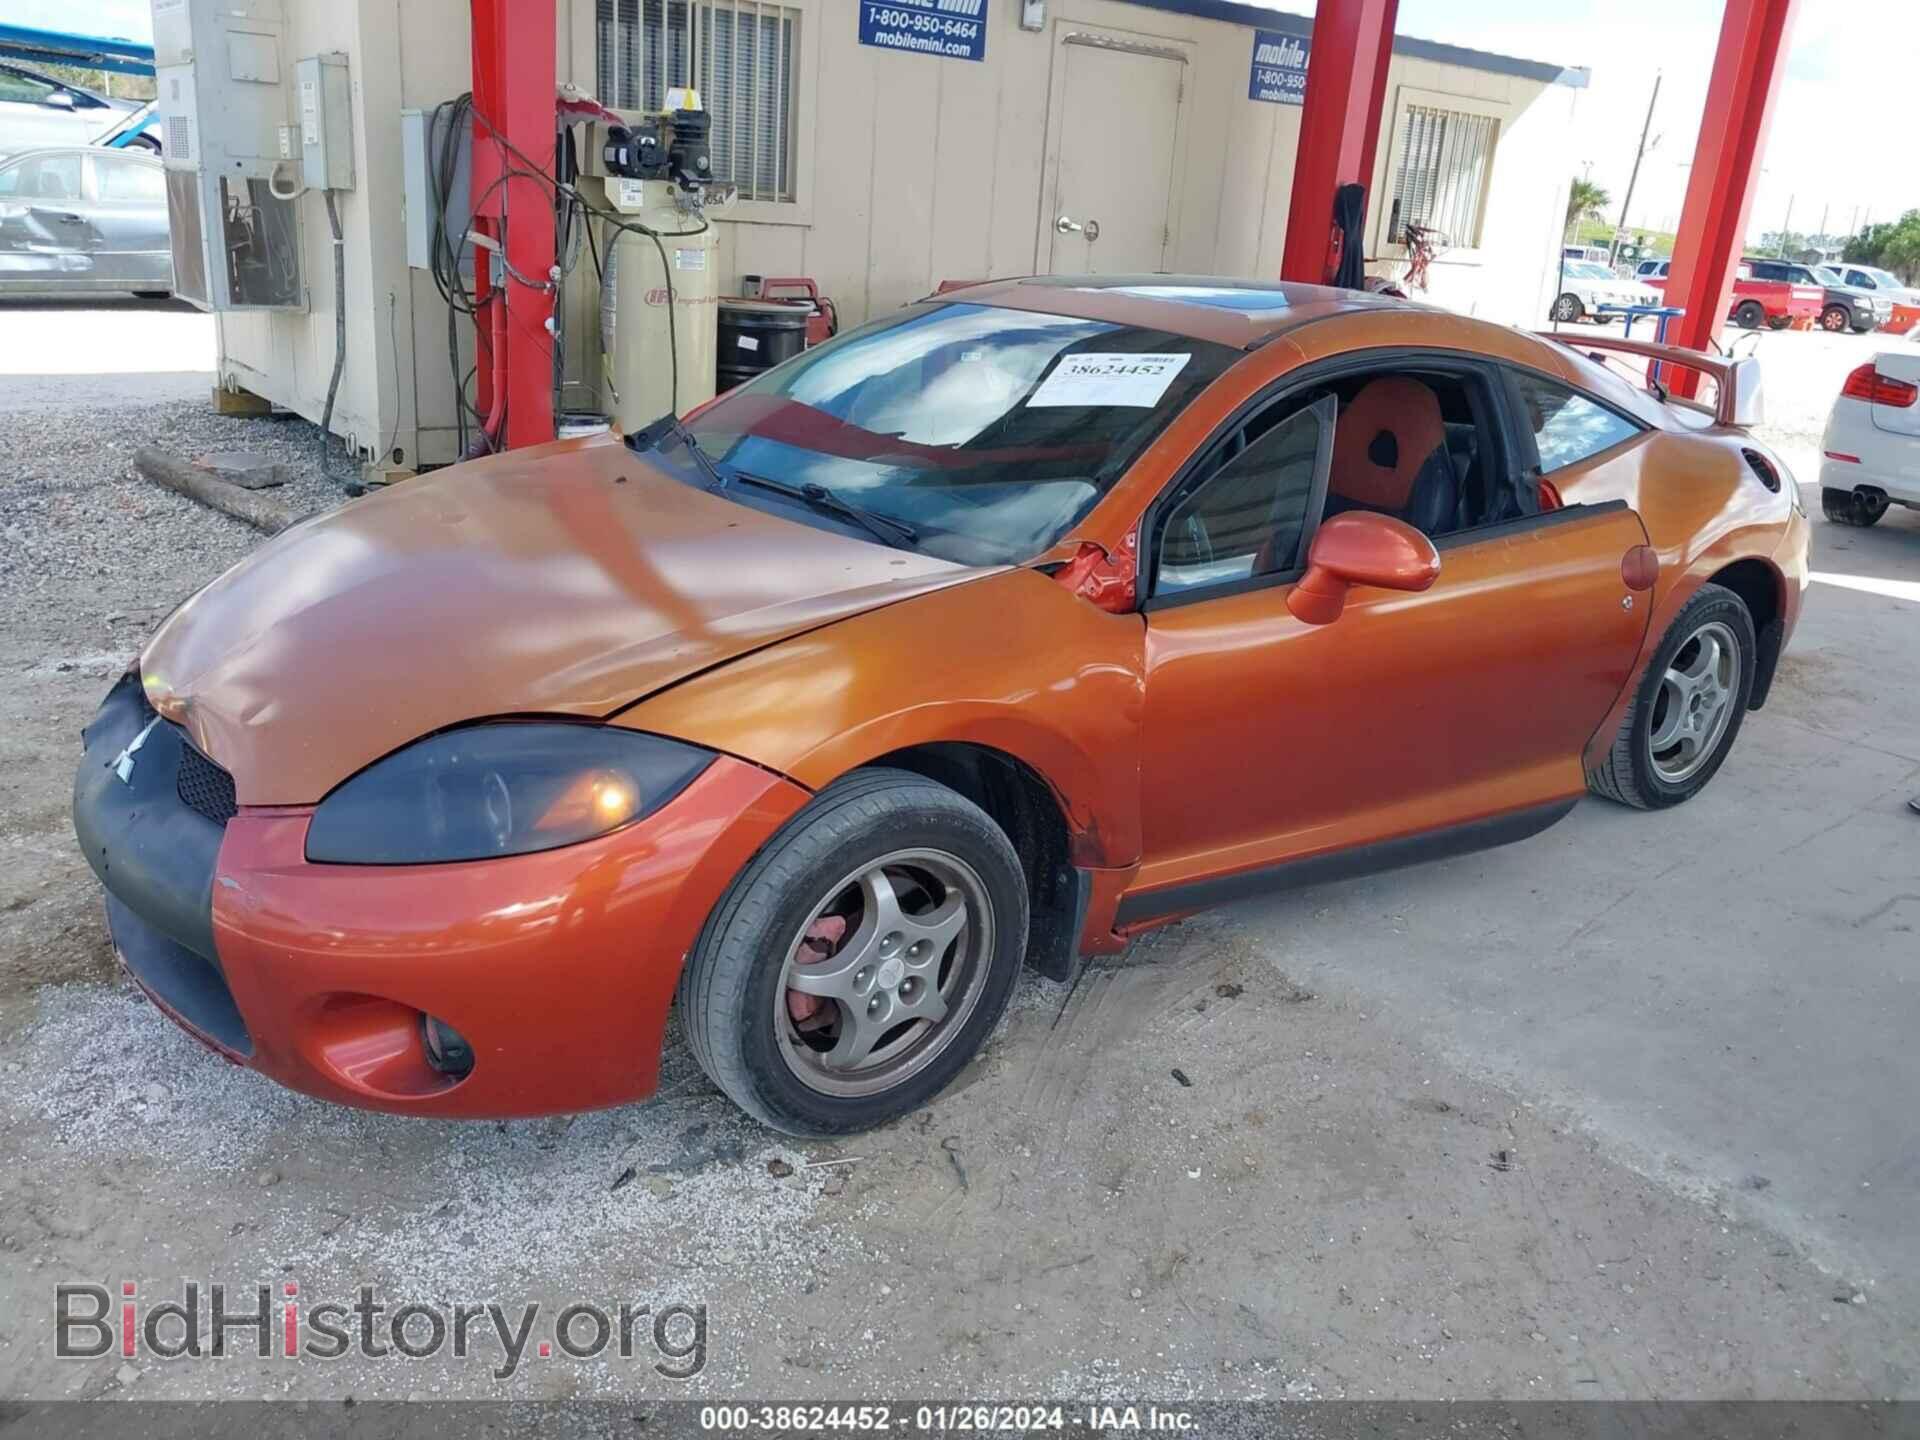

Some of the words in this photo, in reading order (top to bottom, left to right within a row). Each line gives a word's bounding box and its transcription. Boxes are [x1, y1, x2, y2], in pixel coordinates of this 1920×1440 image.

[869, 7, 978, 39] 1-800-950-6464
[874, 31, 971, 57] mobilemini.com
[1255, 37, 1305, 69] mobile
